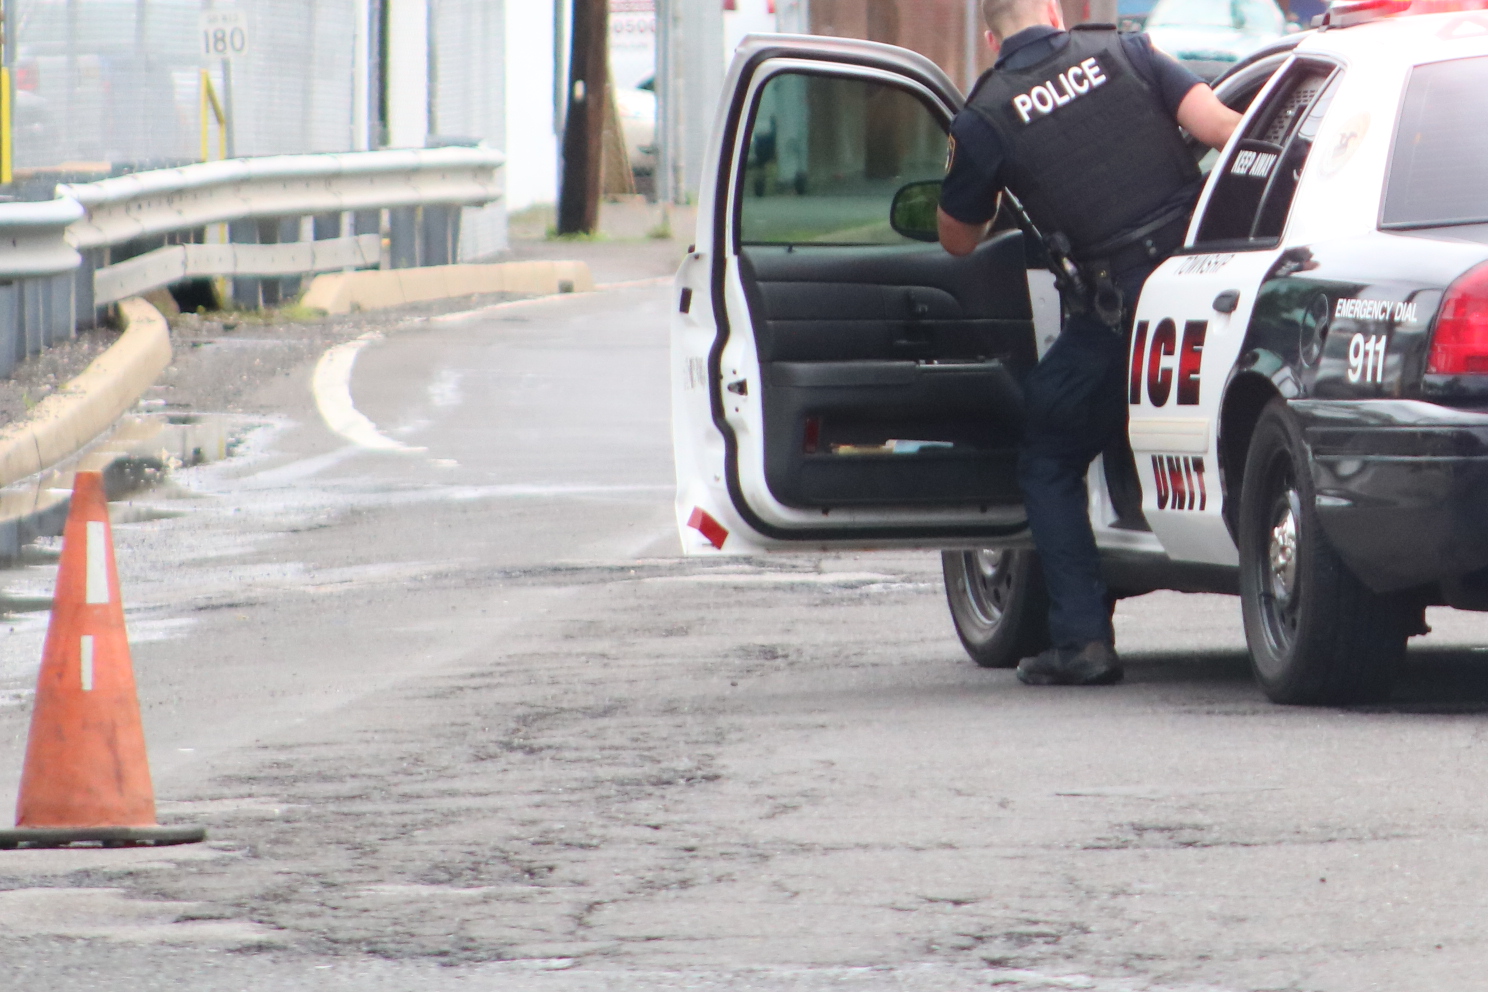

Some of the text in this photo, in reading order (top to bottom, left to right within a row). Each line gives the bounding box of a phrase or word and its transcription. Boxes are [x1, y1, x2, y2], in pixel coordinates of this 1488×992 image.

[203, 26, 246, 55] 180
[1013, 56, 1107, 124] POLICE
[1230, 149, 1278, 177] KEEP AWAY
[1334, 298, 1418, 323] EMERGENCY DIAL
[1347, 332, 1387, 384] 911
[1151, 454, 1207, 511] UNIT
